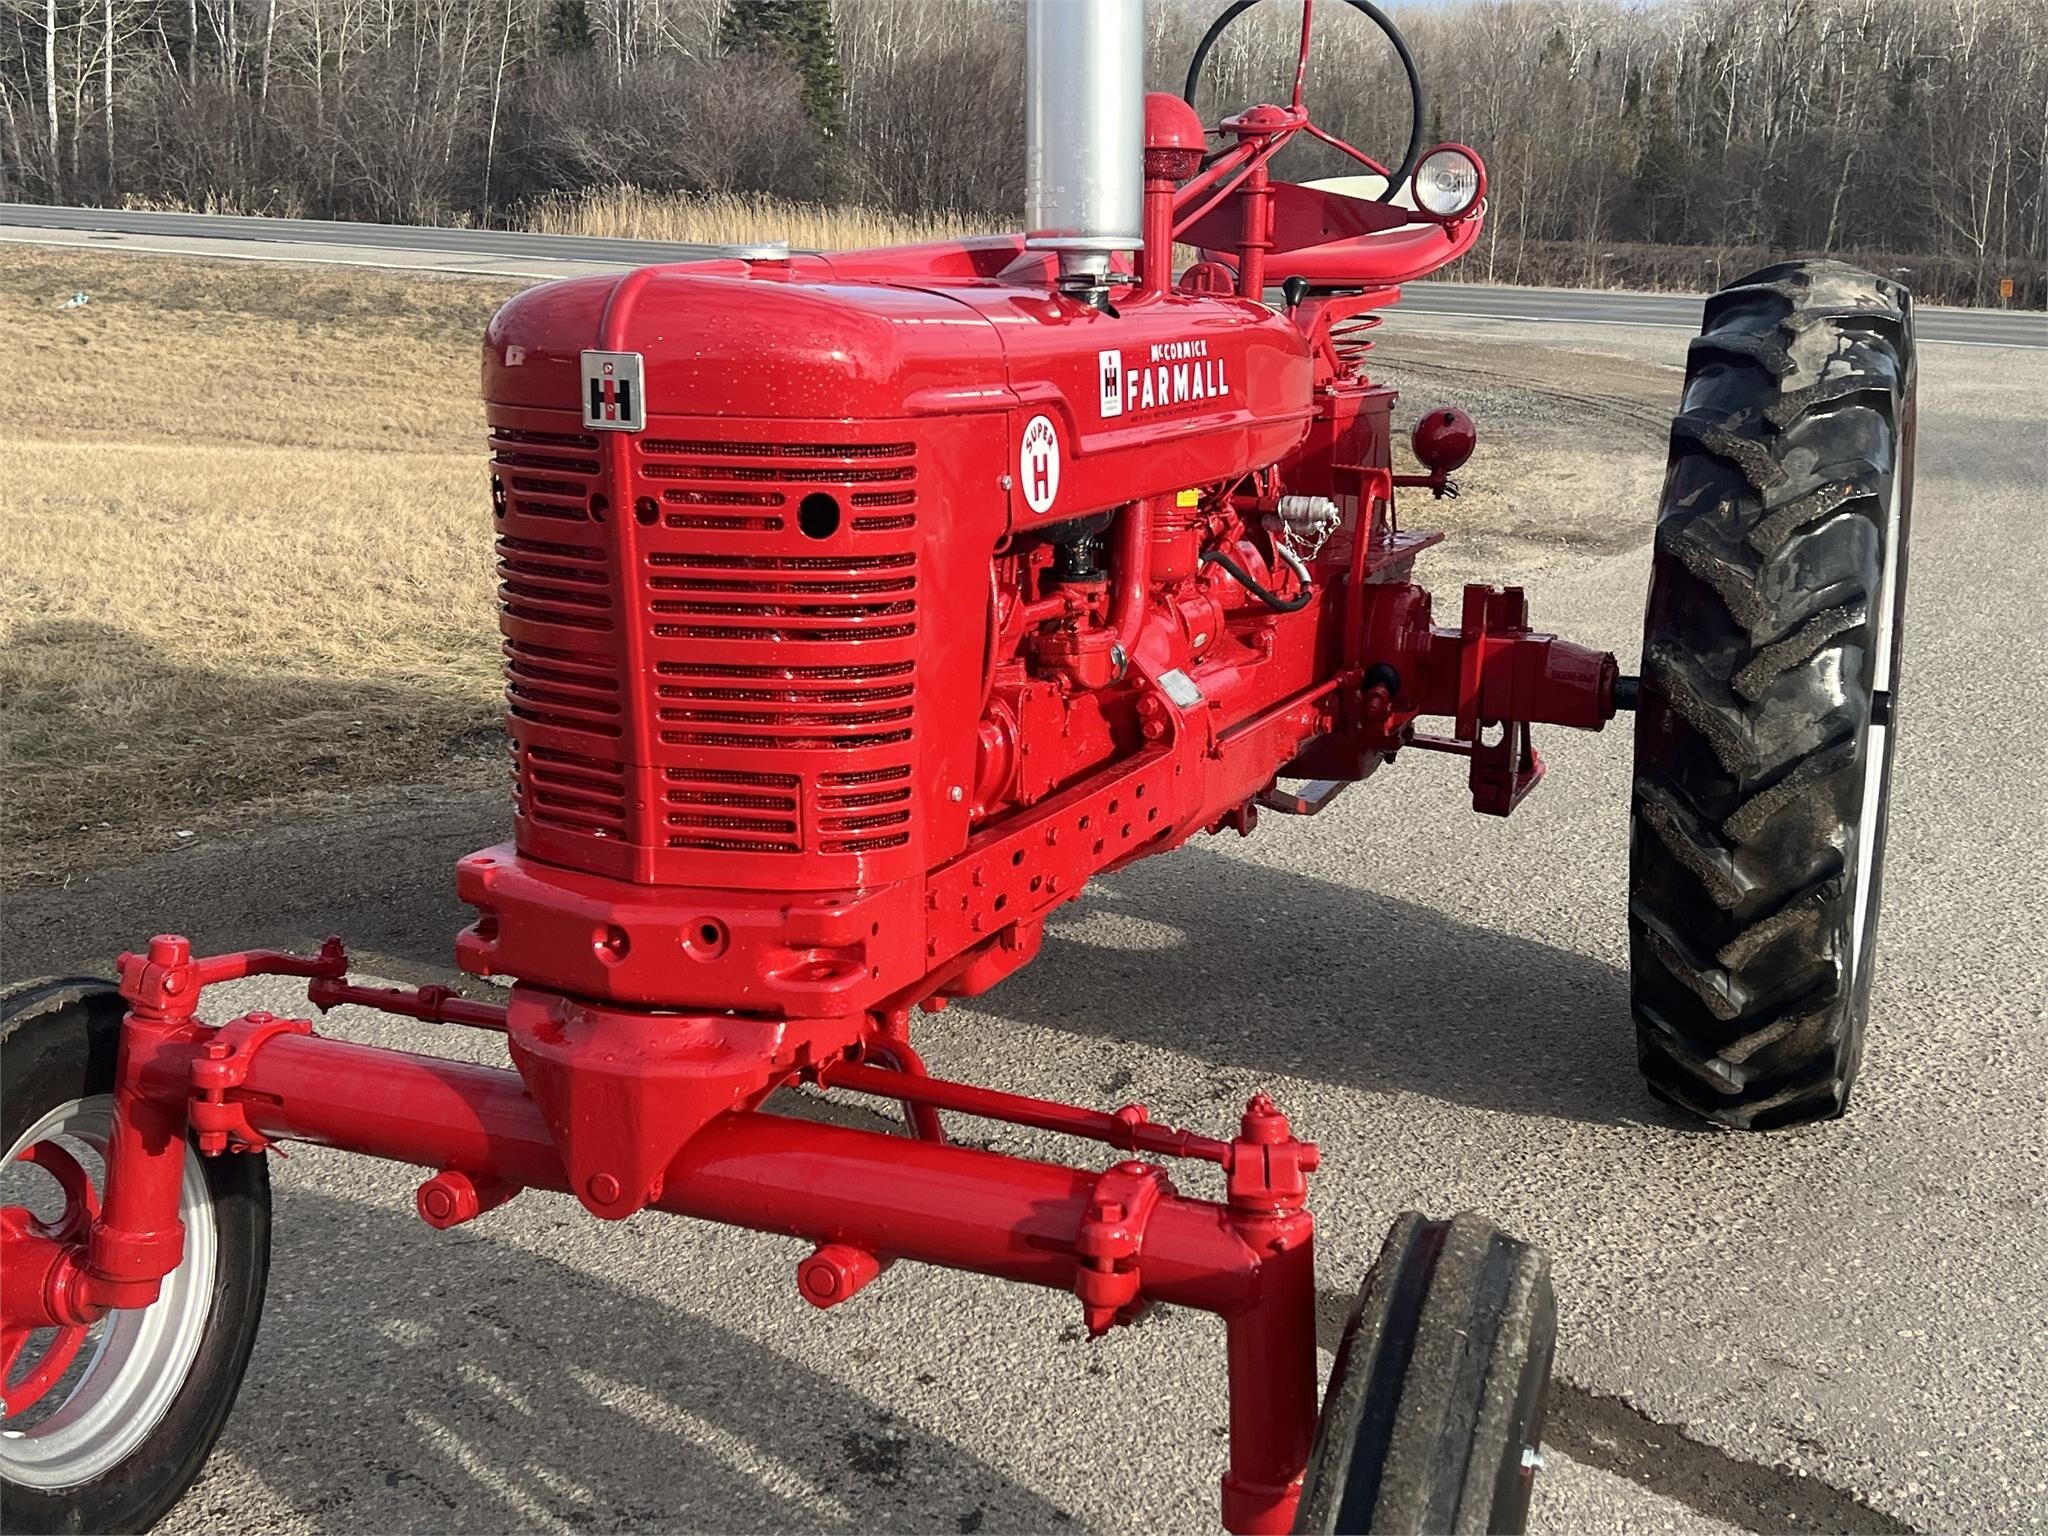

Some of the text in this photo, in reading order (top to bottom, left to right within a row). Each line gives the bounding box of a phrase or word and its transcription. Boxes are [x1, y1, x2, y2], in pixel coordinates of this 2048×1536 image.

[1127, 358, 1229, 411] FARMALL
[1026, 422, 1053, 454] SUPER
[1033, 453, 1049, 501] H
